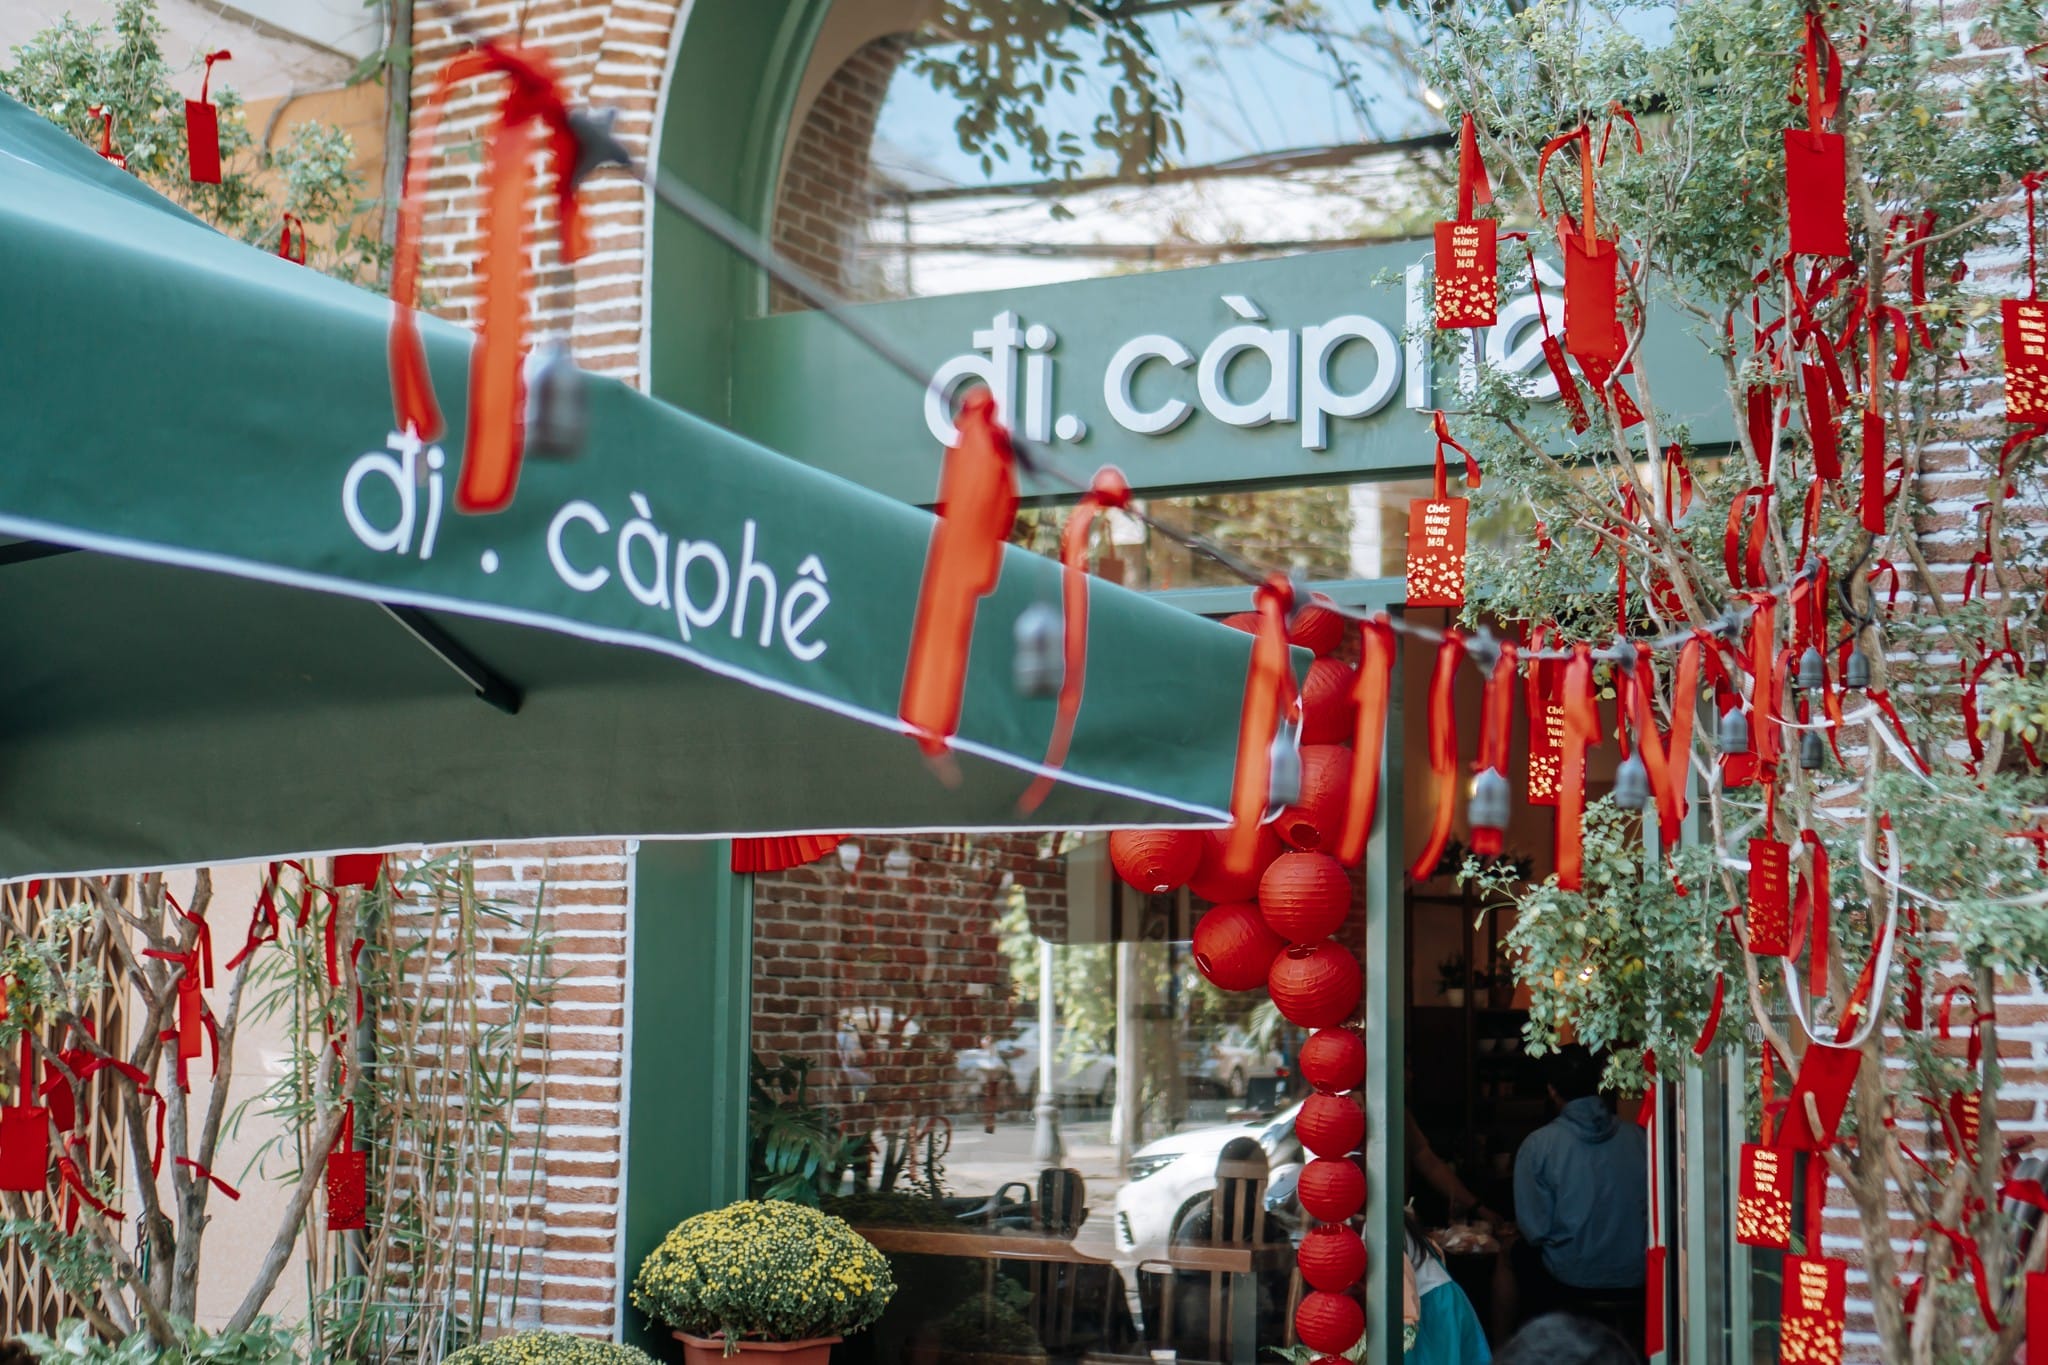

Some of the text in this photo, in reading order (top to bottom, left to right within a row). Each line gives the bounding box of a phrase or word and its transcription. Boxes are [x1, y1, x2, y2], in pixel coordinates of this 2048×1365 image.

[1453, 225, 1479, 235] Chúc
[1452, 236, 1479, 247] Mừng
[1453, 248, 1477, 257] Năm
[1456, 258, 1475, 268] Mới
[1426, 503, 1451, 513] Chúc
[1424, 515, 1450, 526] Mừng
[1425, 526, 1447, 536] Năm
[1426, 537, 1445, 547] Mới
[547, 491, 830, 662] càphê
[1546, 706, 1564, 715] Chú
[1546, 716, 1564, 726] Mừn
[1549, 738, 1563, 747] Mớ
